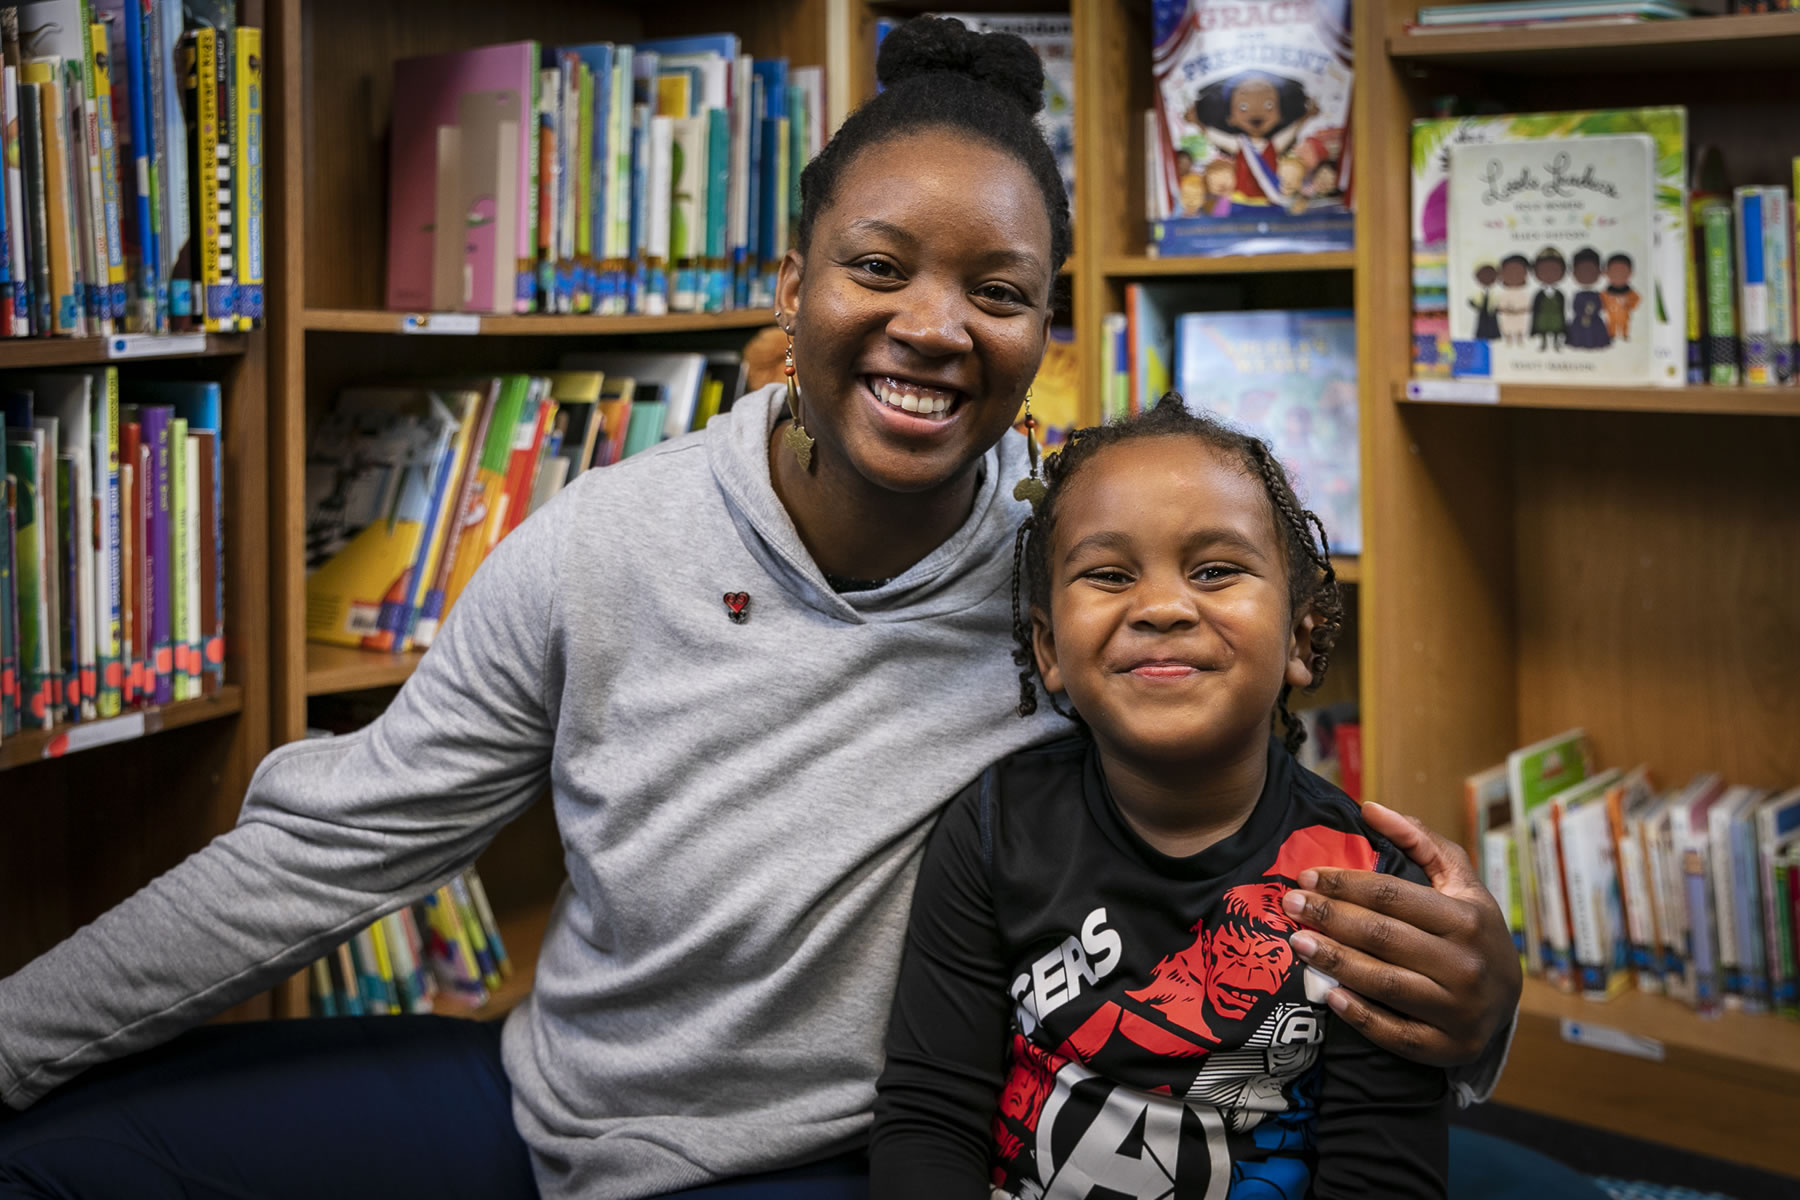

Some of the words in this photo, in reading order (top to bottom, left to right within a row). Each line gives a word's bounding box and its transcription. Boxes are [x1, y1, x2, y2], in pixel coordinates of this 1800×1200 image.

[1193, 1, 1314, 31] GRACE
[1182, 46, 1331, 81] PRESIDENT
[1011, 907, 1122, 1036] GERS
